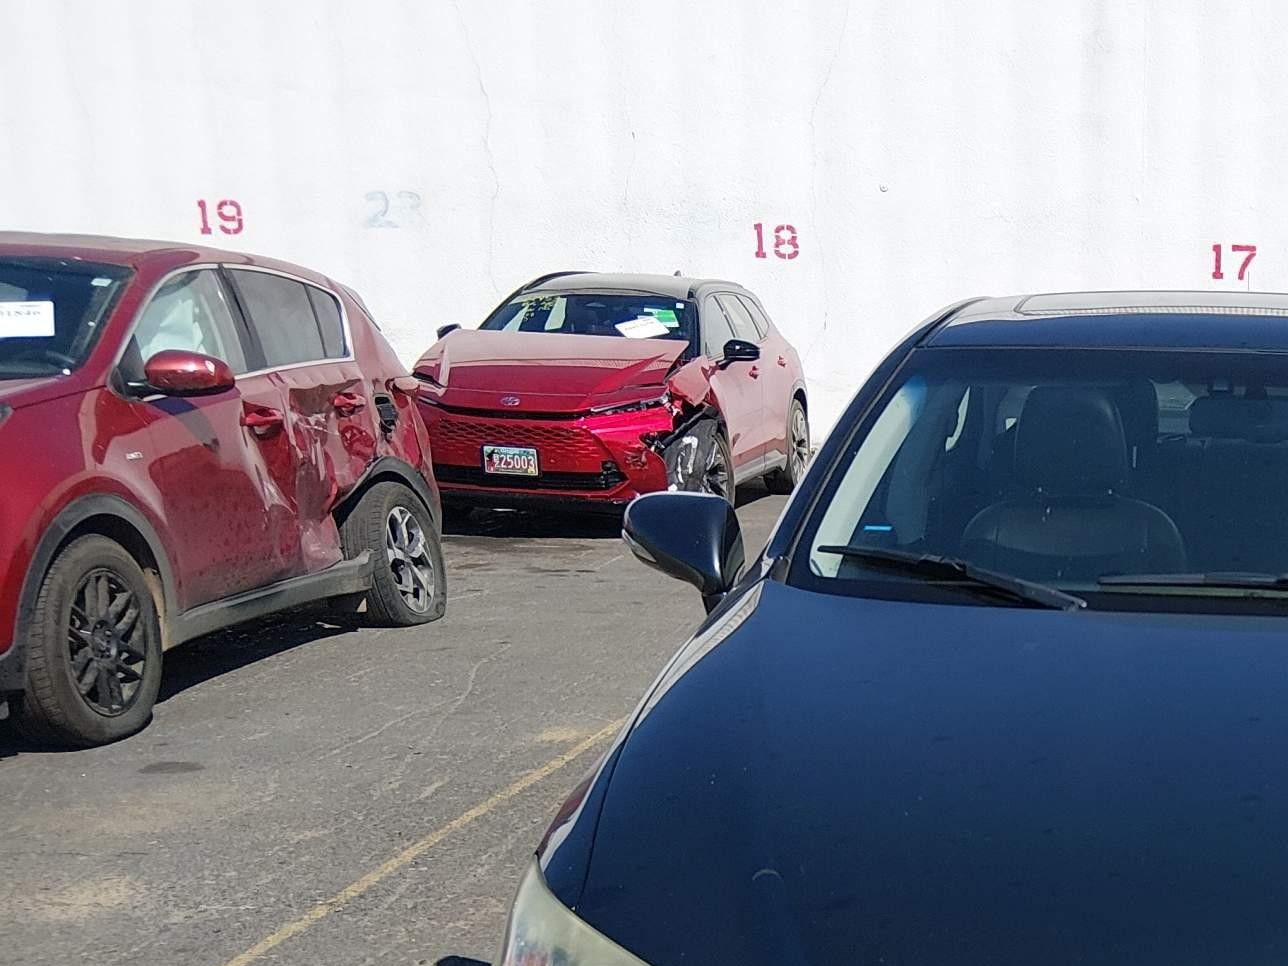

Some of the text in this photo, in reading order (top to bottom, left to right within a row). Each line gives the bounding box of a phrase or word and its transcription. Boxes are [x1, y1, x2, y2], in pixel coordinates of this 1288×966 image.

[198, 200, 243, 234] 19
[754, 223, 798, 258] 18
[1211, 244, 1257, 281] 17
[500, 454, 535, 469] 25003
